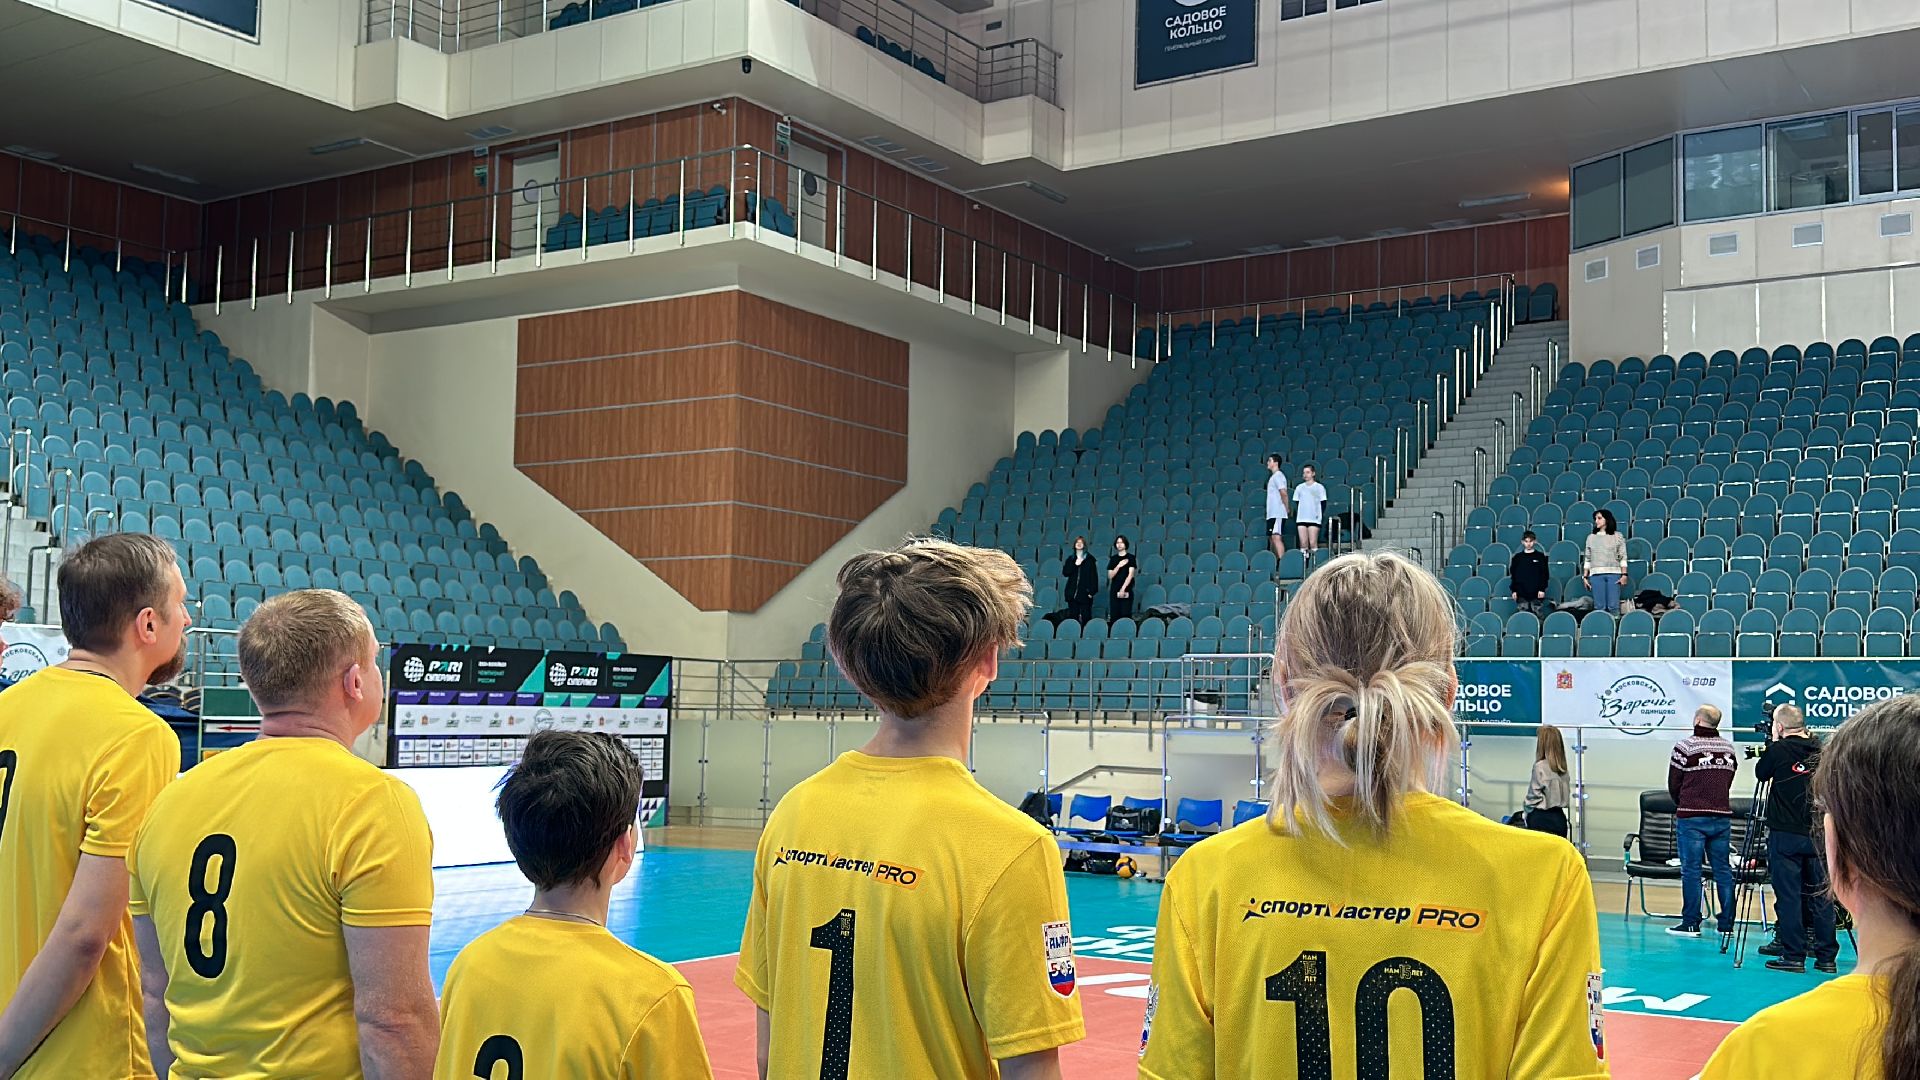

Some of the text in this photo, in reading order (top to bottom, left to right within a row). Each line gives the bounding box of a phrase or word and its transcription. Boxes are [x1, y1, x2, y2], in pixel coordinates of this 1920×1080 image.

[1165, 6, 1227, 28] САДОВОЕ
[1169, 20, 1223, 40] КОЛЬЦО
[428, 660, 463, 673] PARI
[570, 666, 599, 677] PARI
[1692, 677, 1717, 687] ВФВ
[1456, 684, 1512, 699] ДОВОЕ
[1453, 699, 1502, 715] ЛЬЦО
[1602, 697, 1676, 718] Заречье
[1805, 703, 1866, 718] КОЛЬ
[876, 864, 917, 885] PRO
[185, 834, 237, 979] 8
[1417, 908, 1480, 929] PRO
[1302, 960, 1318, 976] 15
[1398, 964, 1412, 980] 15
[1411, 969, 1424, 977] ЛЕТ
[809, 908, 856, 1080] 1
[1265, 950, 1455, 1080] 10
